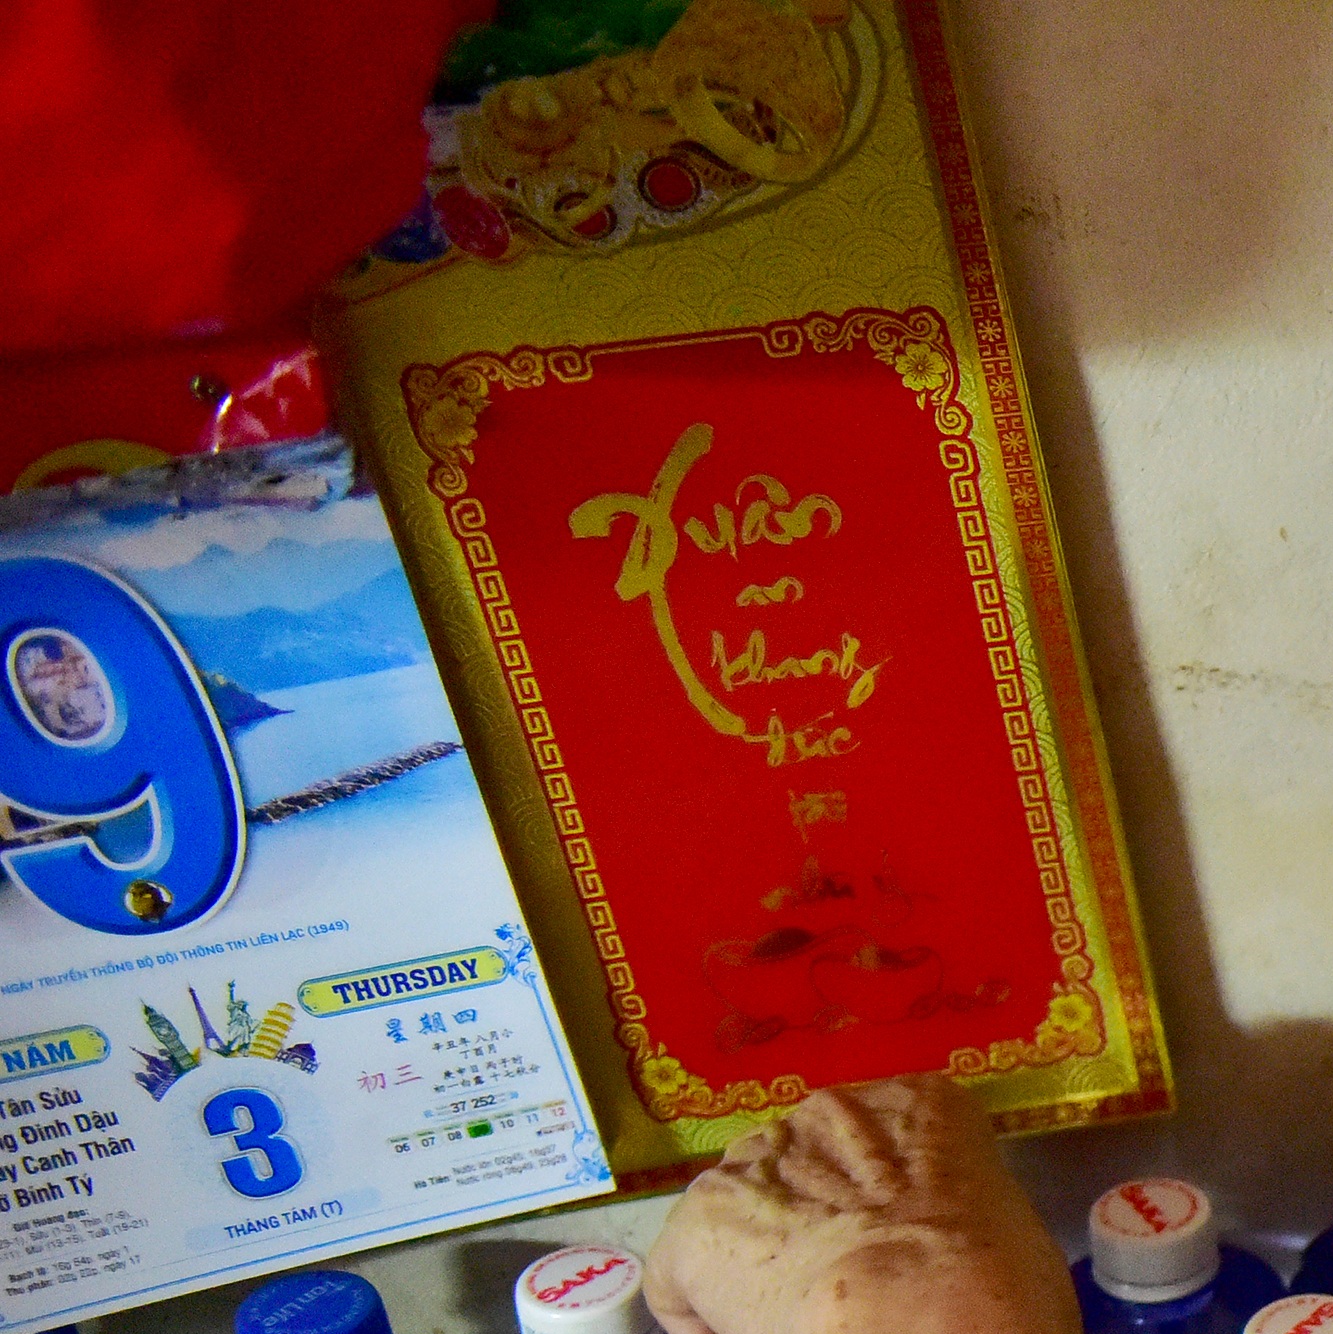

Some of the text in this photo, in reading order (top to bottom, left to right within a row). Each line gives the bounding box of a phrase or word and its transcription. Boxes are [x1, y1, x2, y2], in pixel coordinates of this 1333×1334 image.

[736, 576, 804, 607] an
[711, 629, 893, 709] khang
[182, 944, 225, 961] THÔNG
[226, 939, 248, 951] TIN
[251, 932, 279, 947] LIÊN
[281, 928, 306, 943] LẠC
[307, 920, 350, 939] (1949)
[332, 958, 478, 1004] THURSDAY
[386, 1008, 478, 1044] 星期四
[357, 1064, 424, 1093] 初三
[39, 1086, 84, 1111] Sửu
[450, 1094, 498, 1115] 37 252
[20, 1119, 73, 1145] Đinh
[73, 1110, 121, 1133] Dậu
[202, 1087, 304, 1199] 3
[394, 1142, 412, 1154] 06
[421, 1136, 436, 1149] 07
[446, 1130, 463, 1142] 08
[500, 1119, 515, 1130] 10
[22, 1148, 79, 1175] Canh
[79, 1137, 137, 1162] Thân
[223, 1200, 344, 1239] THÁNG TÁM (T)
[1120, 1184, 1167, 1233] SAKA
[535, 1258, 629, 1303] SAKA
